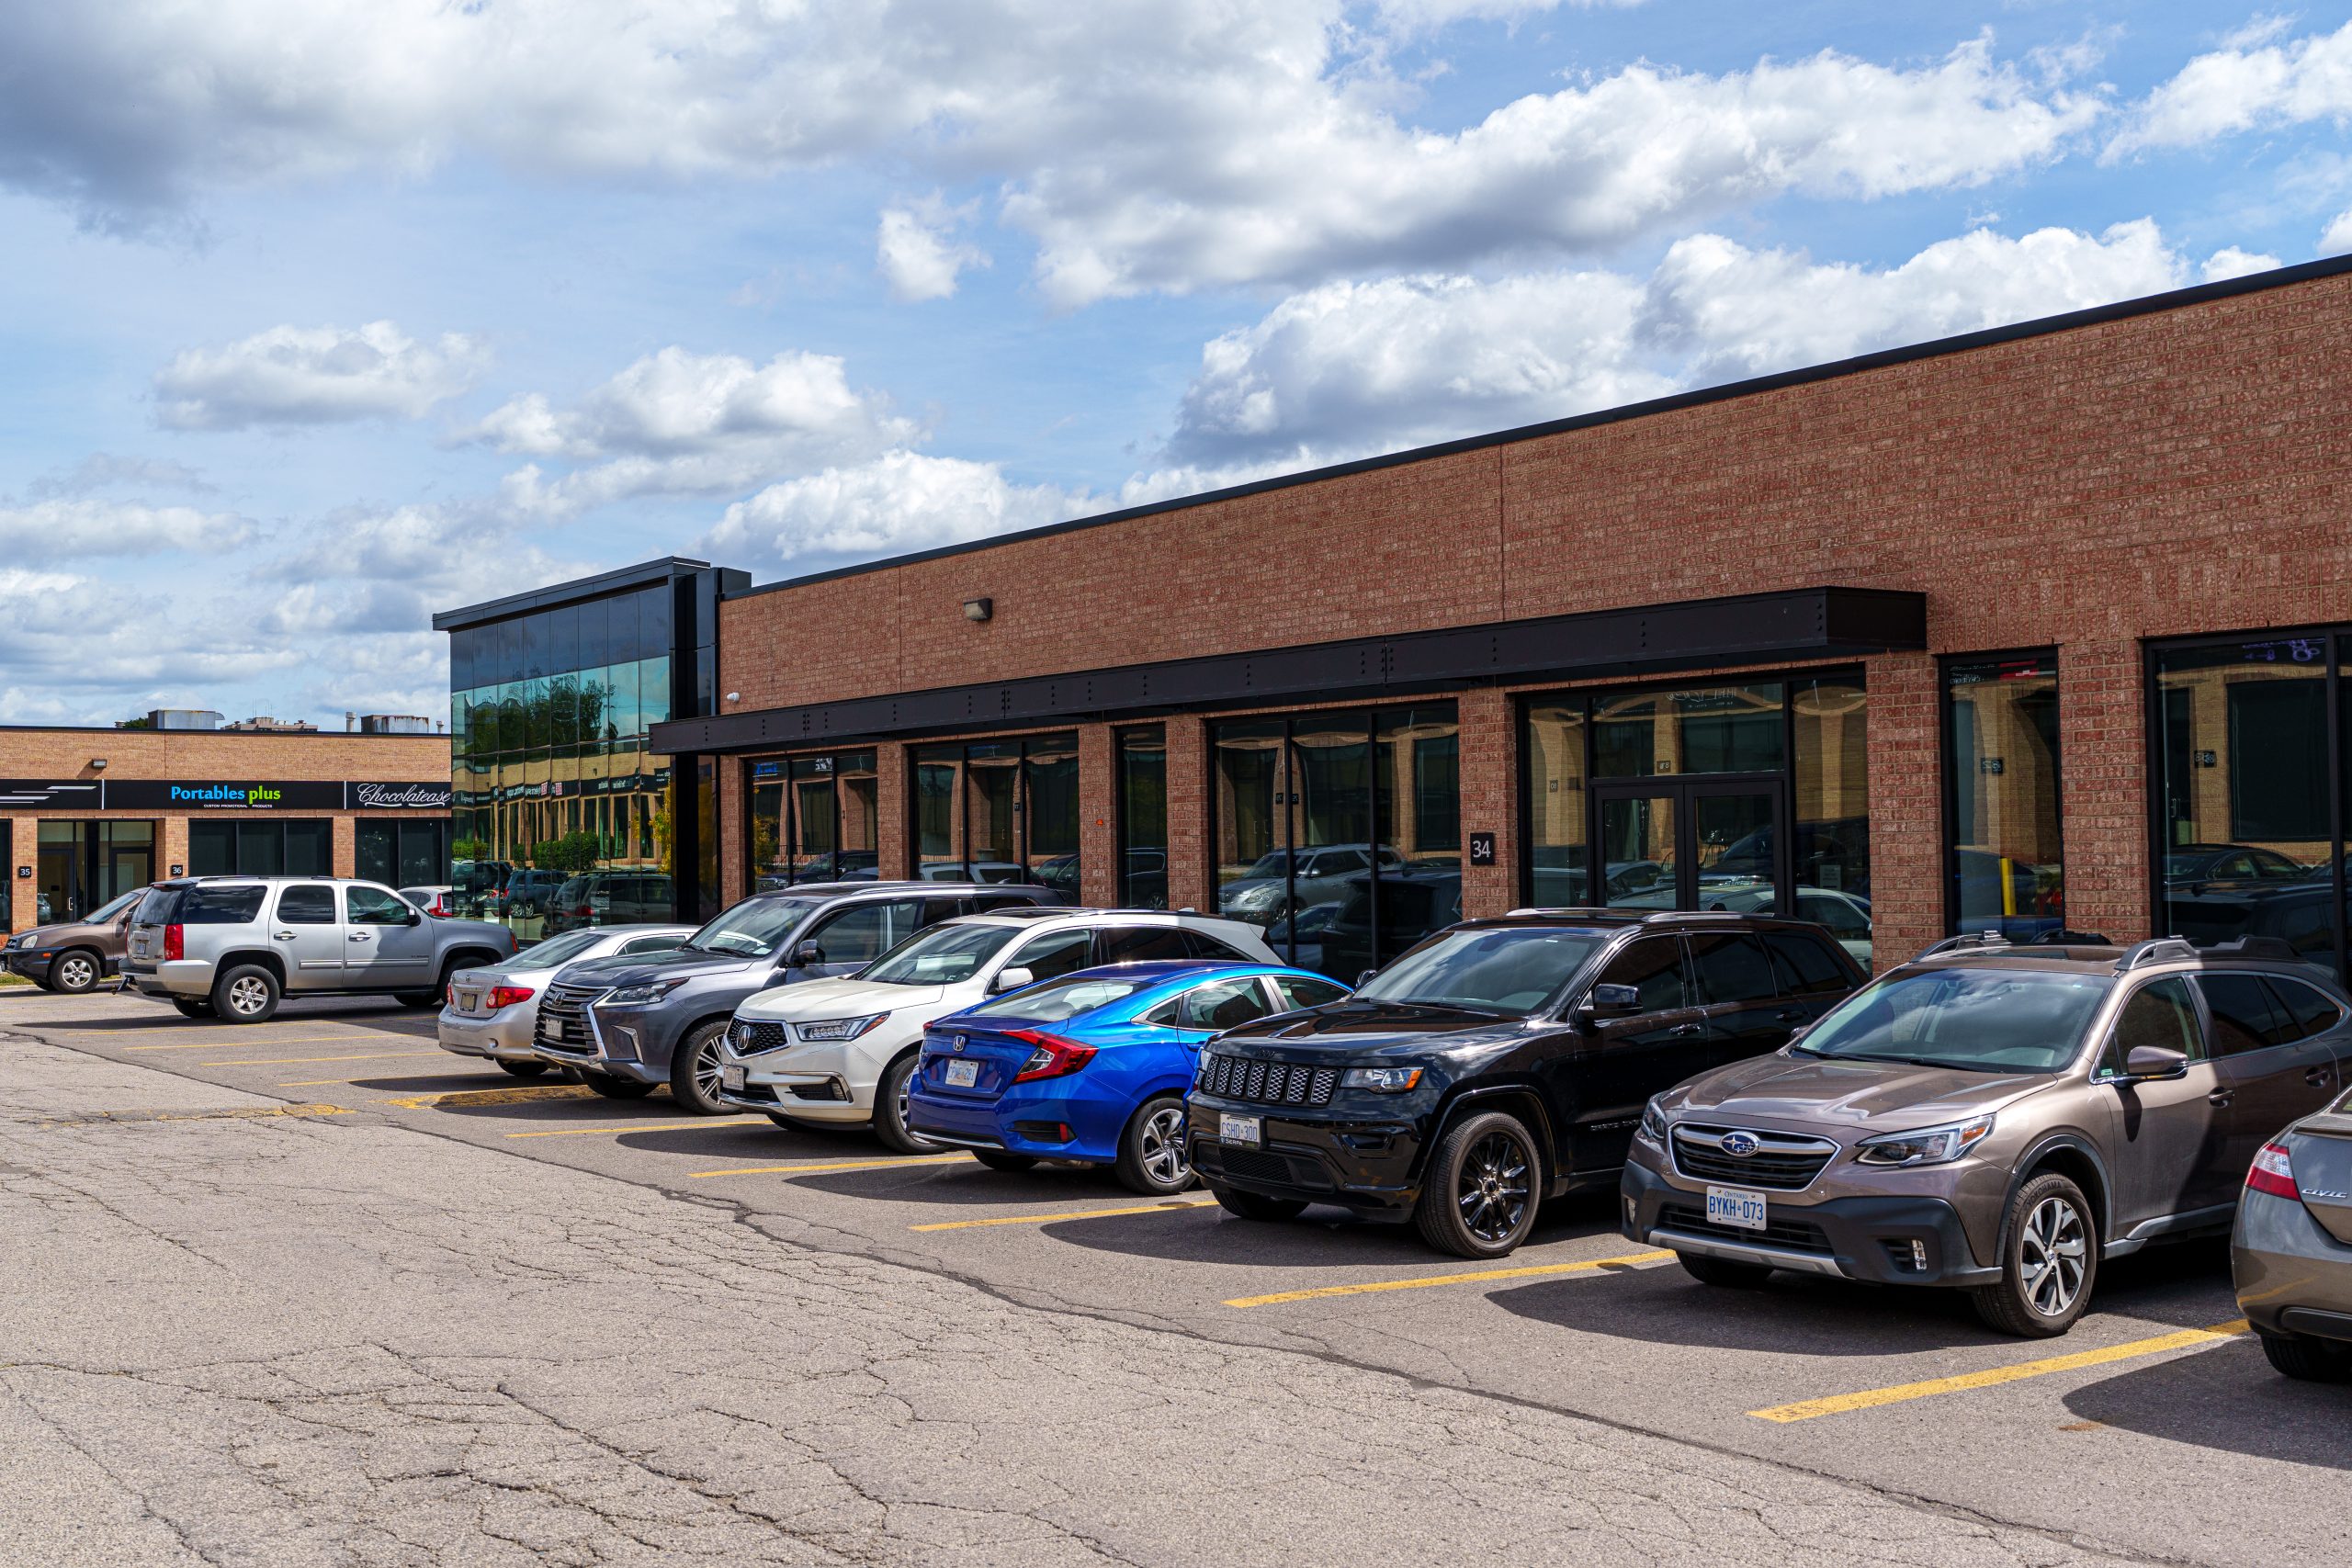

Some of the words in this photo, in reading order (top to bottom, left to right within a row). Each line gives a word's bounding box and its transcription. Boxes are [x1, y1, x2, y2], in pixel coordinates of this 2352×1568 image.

[171, 785, 245, 800] Portables
[248, 785, 280, 805] plus
[357, 784, 451, 803] Chocolatease
[1472, 840, 1491, 858] 34
[20, 868, 30, 876] 35
[172, 866, 182, 874] 36
[2026, 1180, 2062, 1206] YOKOHAMA
[2301, 1189, 2348, 1199] CIVIC
